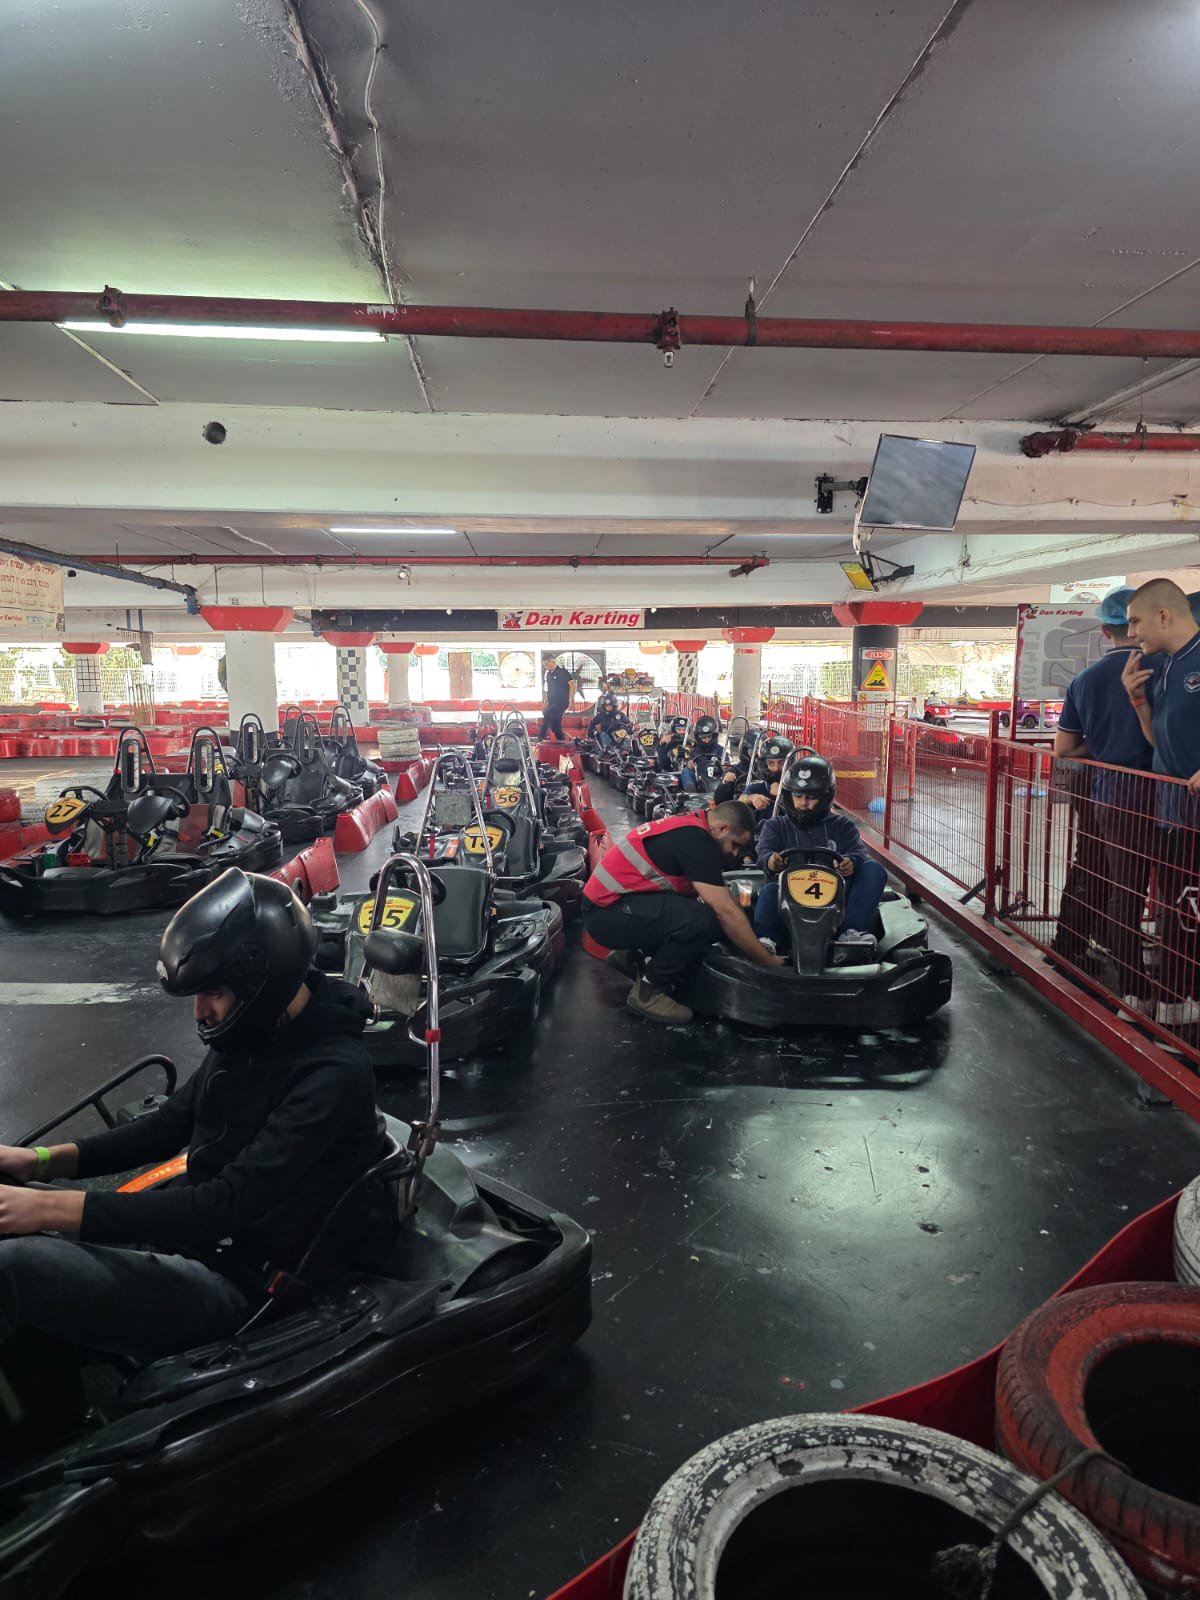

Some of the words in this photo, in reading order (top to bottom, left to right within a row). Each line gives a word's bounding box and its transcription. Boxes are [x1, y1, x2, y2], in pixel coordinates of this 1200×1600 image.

[525, 611, 563, 626] Dan
[568, 611, 640, 627] Karting
[498, 793, 518, 804] 56
[49, 804, 78, 818] 27
[804, 882, 823, 900] 4
